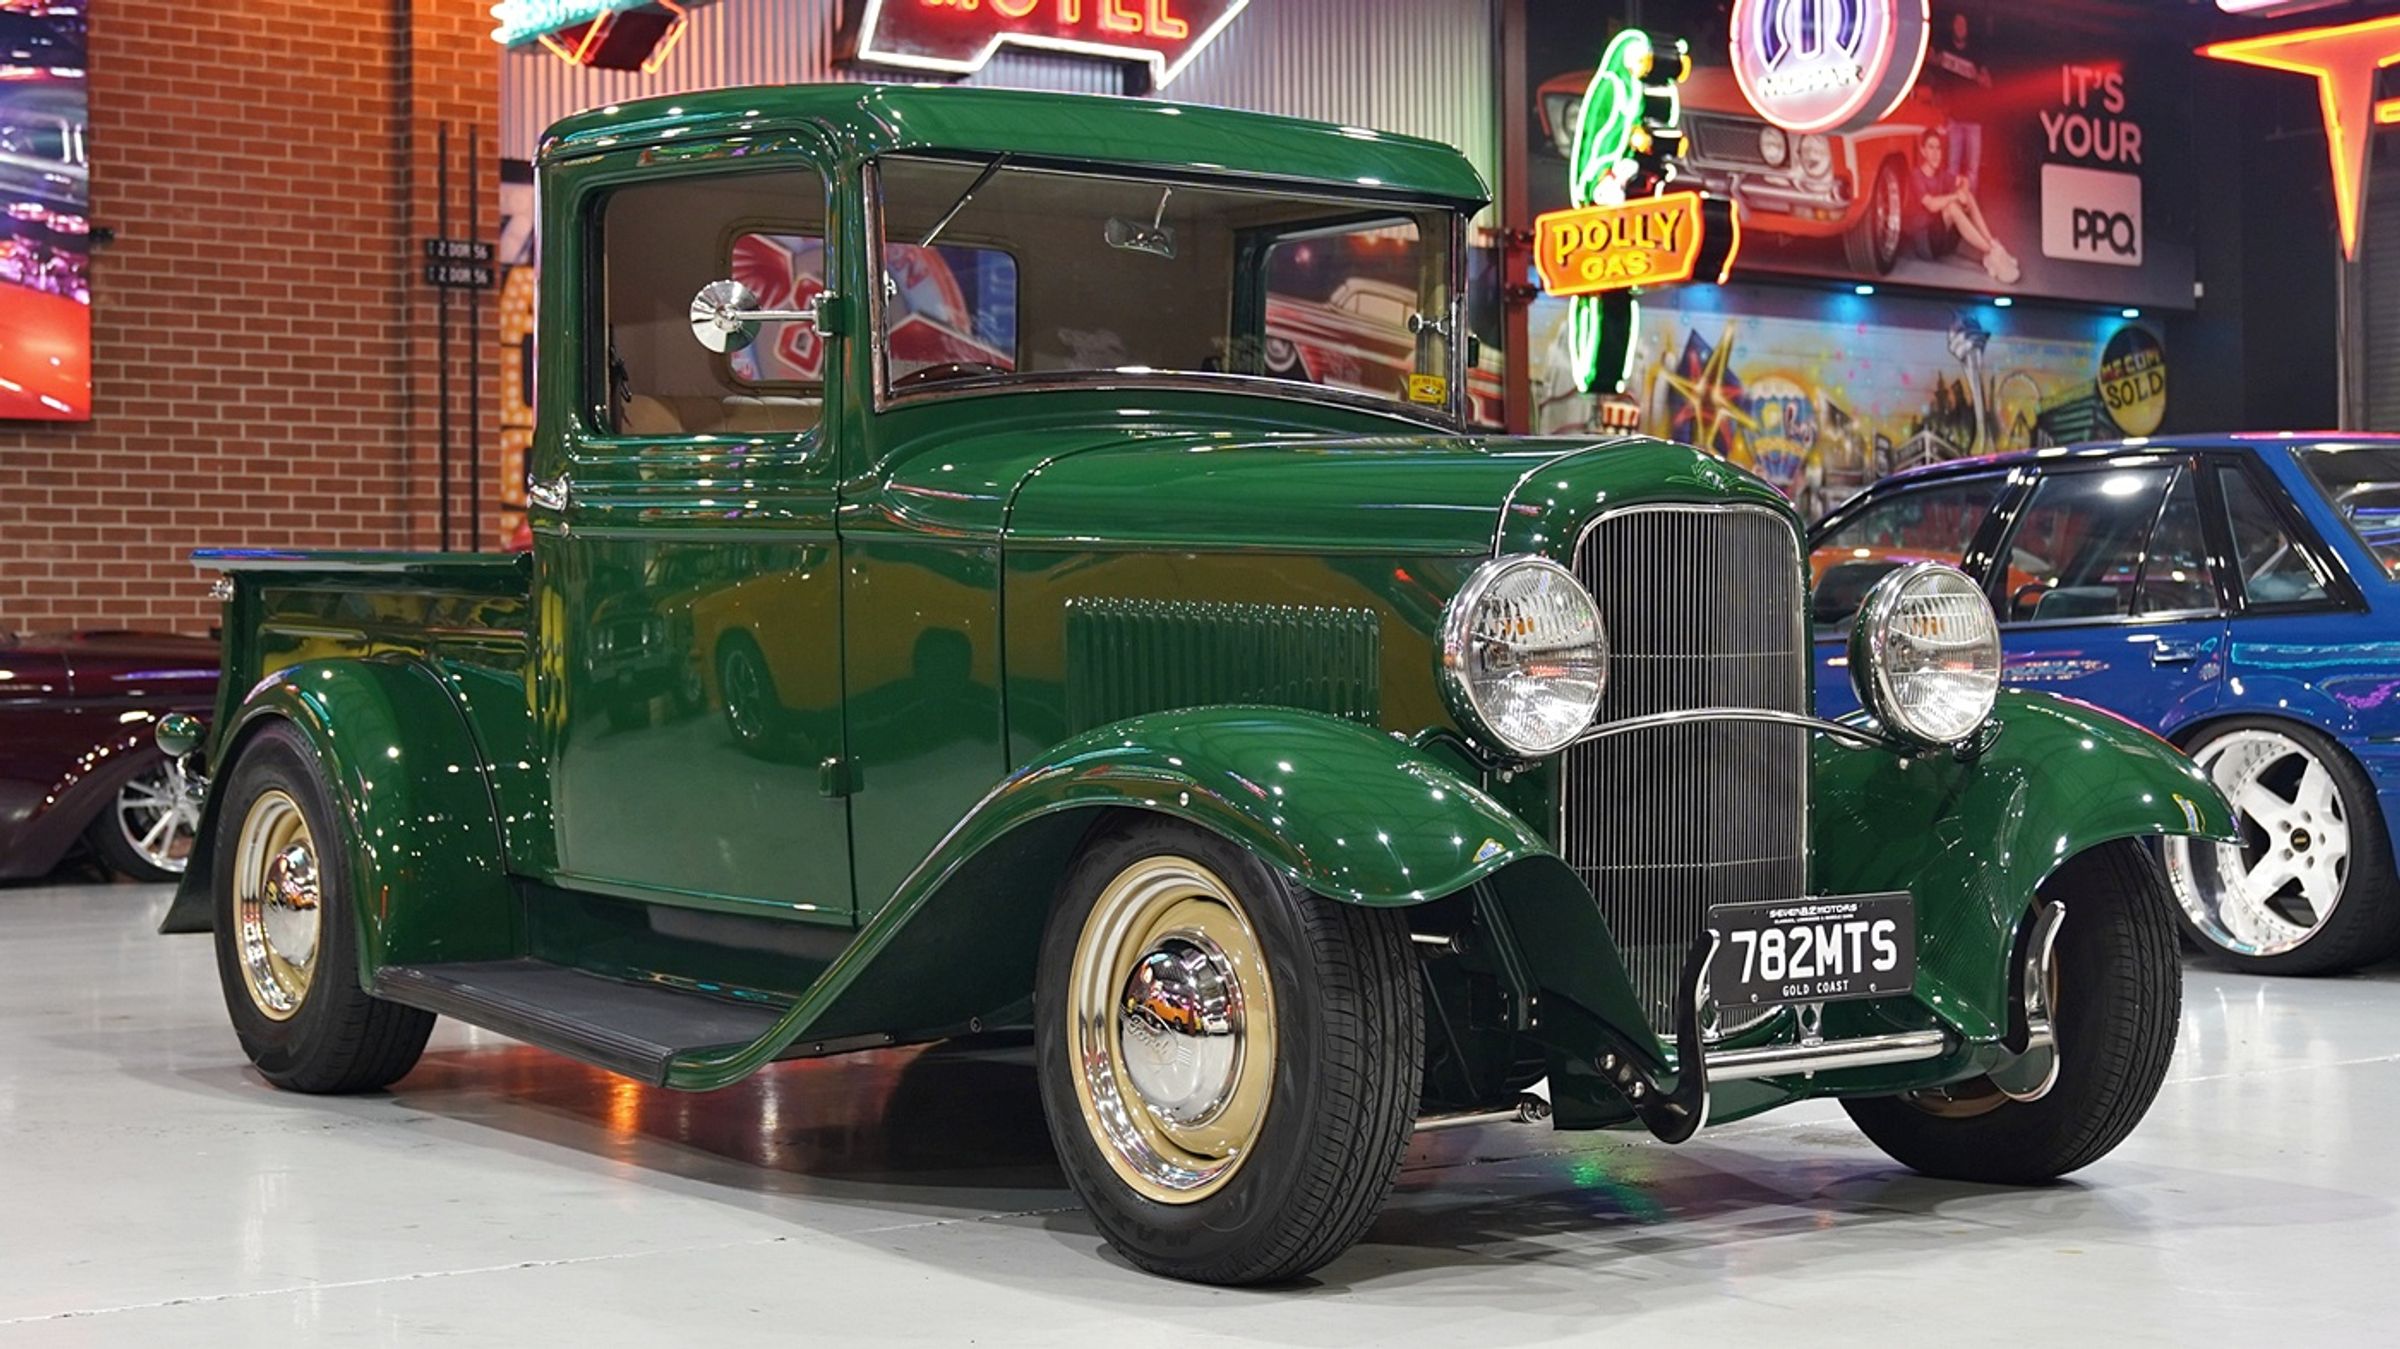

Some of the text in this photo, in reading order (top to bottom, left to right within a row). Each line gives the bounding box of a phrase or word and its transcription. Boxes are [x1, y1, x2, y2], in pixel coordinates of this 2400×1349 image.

[2062, 64, 2125, 114] IT'S
[2040, 110, 2142, 165] YOUR
[1552, 208, 1684, 266] POLLY
[2072, 207, 2136, 257] PPQ
[1580, 251, 1650, 281] GAS
[2106, 371, 2163, 410] SOLD
[1731, 919, 1898, 984] 782MTS
[1783, 980, 1849, 997] GOLD COAST
